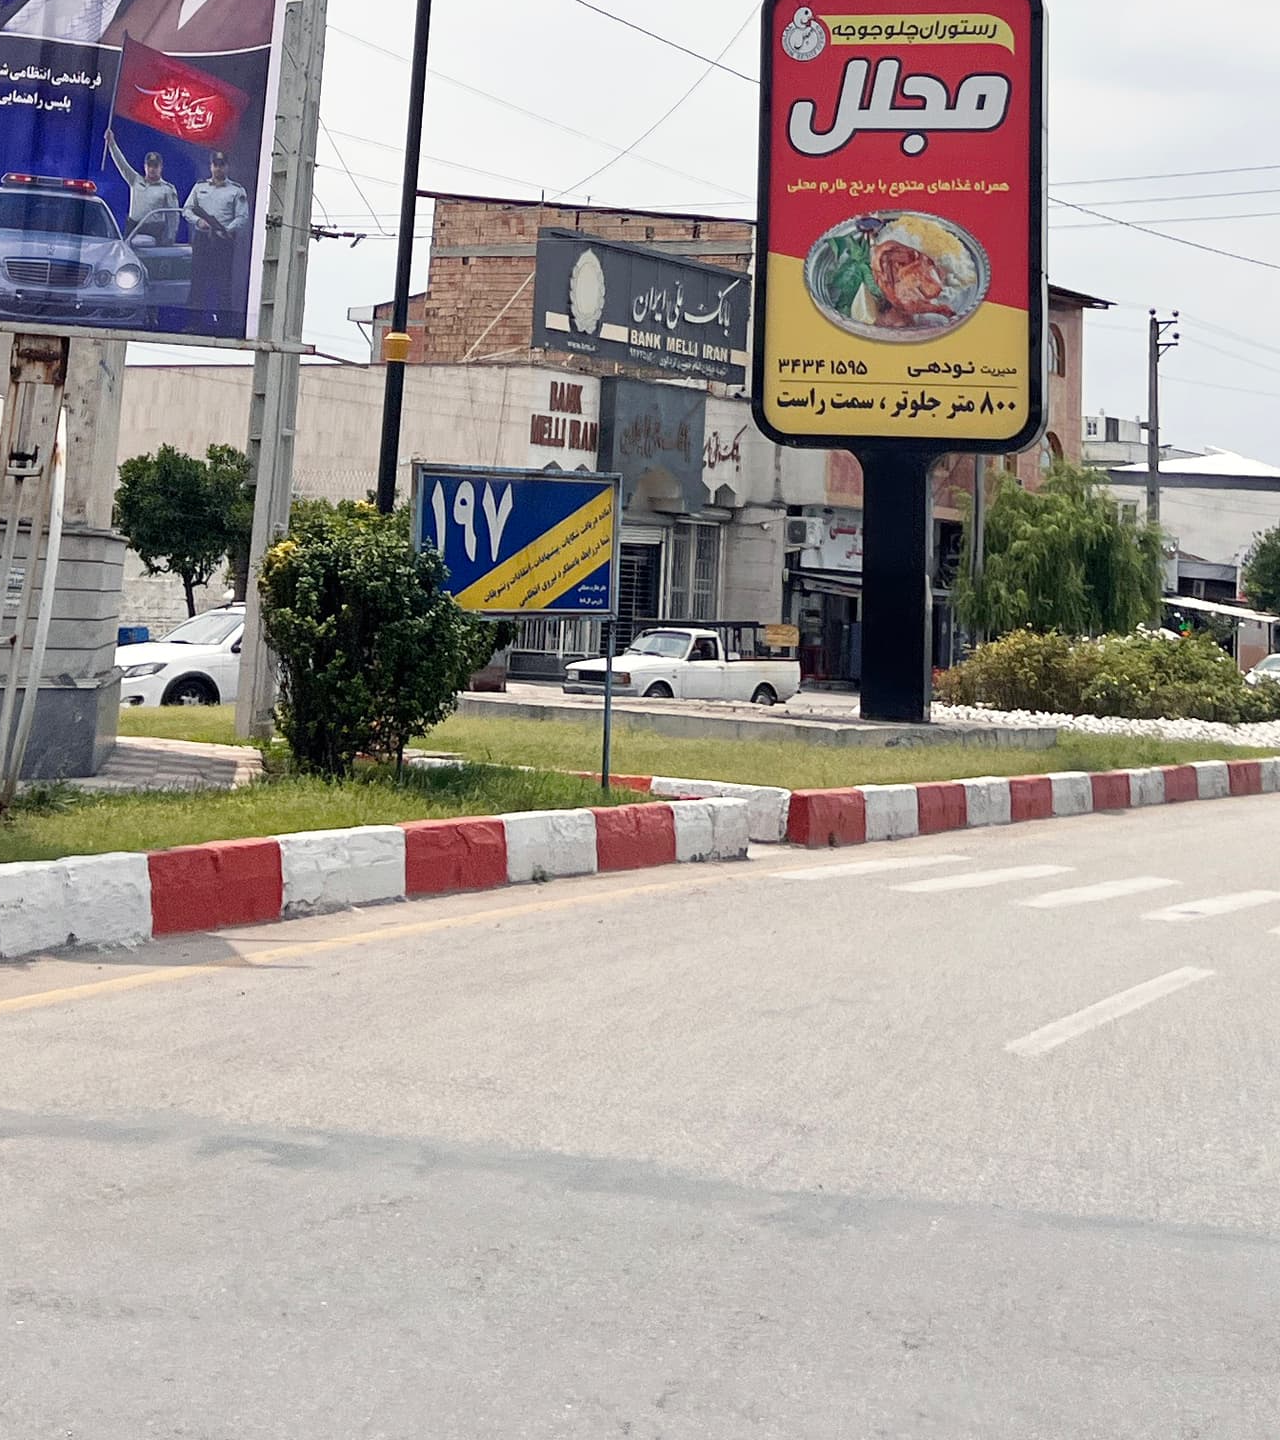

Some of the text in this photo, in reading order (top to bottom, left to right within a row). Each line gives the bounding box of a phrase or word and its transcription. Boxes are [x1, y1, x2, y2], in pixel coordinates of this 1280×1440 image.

[919, 19, 997, 40] رستوران
[9, 65, 51, 81] انتظامی
[51, 71, 102, 89] فرماندهی
[44, 96, 71, 111] پلیس
[787, 57, 1011, 156] مجلل
[787, 177, 1010, 197] همراه غذاهای متنوع با برنج طارم محلی
[633, 279, 741, 336] بانک ملی ایران
[630, 329, 662, 350] BANK
[666, 337, 698, 357] MELLI
[702, 343, 728, 362] IRAN
[907, 360, 975, 379] نودهی
[980, 365, 1017, 378] مدیریت
[550, 381, 583, 414] BANK
[777, 388, 825, 415] راست
[830, 392, 874, 410] سمت
[890, 390, 941, 418] جلوتر
[947, 395, 975, 418] متر
[980, 391, 1016, 414] ۸۰۰
[530, 414, 566, 448] MELLI
[568, 419, 598, 453] IRAN
[431, 479, 513, 563] ۱۹۷
